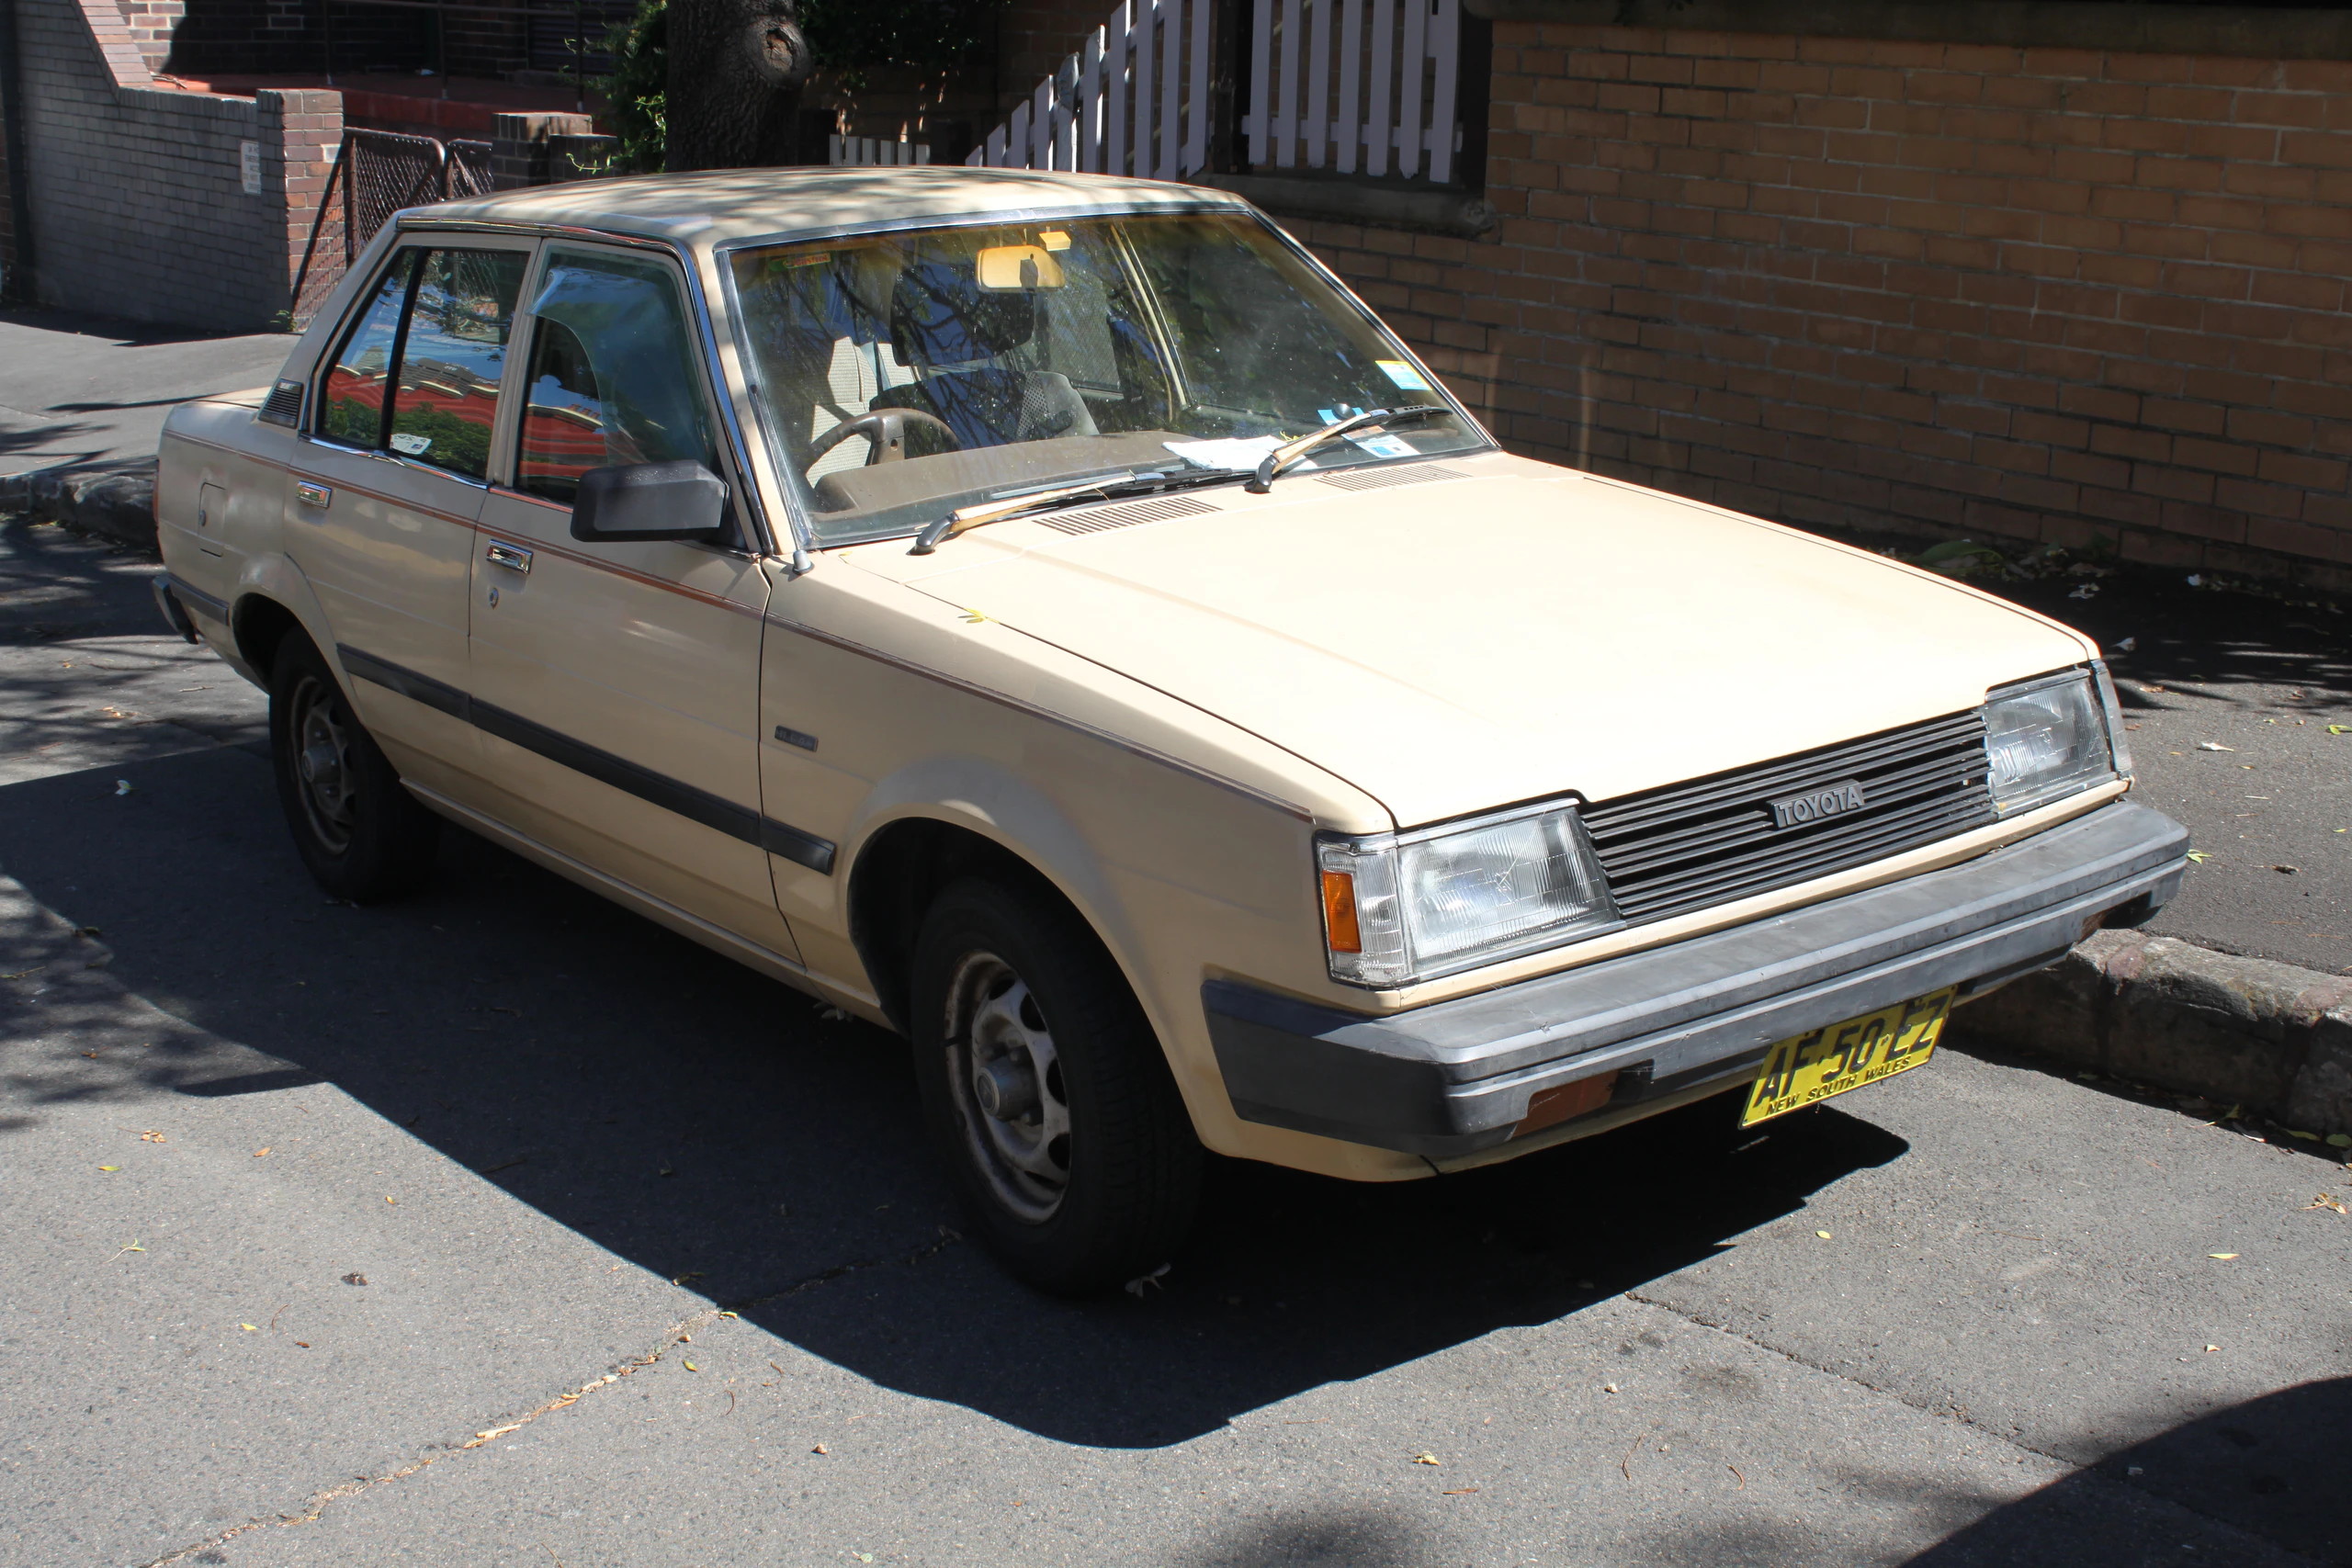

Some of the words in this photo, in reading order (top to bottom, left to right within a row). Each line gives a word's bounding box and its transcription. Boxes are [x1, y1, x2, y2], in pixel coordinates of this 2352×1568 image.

[1779, 786, 1864, 825] TOYOTA
[1765, 1092, 1801, 1114] NEW
[1806, 1074, 1858, 1101] SOUTH
[1864, 1055, 1911, 1080] WALES
